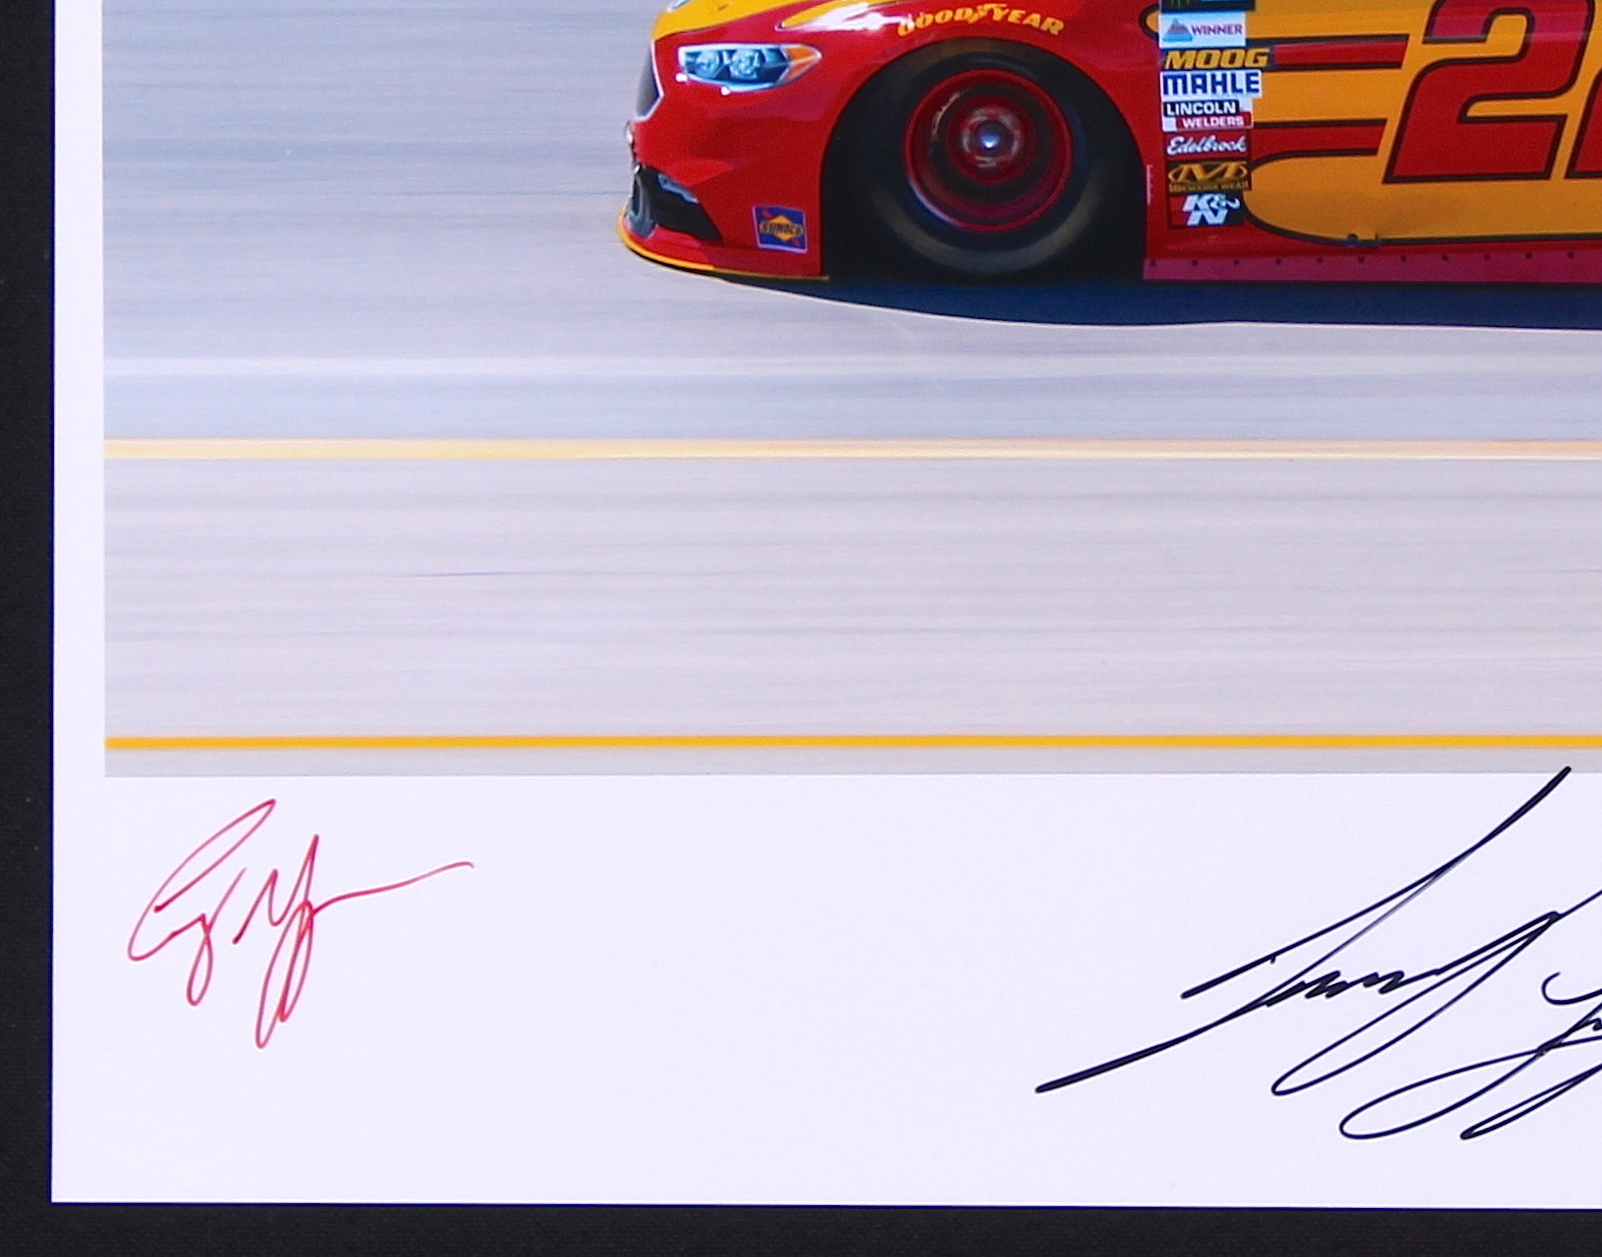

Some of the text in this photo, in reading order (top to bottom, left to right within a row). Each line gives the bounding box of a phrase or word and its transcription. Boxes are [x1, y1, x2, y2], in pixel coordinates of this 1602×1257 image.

[897, 3, 1064, 36] GOODYEAR
[1191, 24, 1242, 36] WINNER
[1165, 48, 1269, 69] MOOG
[1163, 72, 1259, 95] MAHLE
[1167, 102, 1236, 115] LINCOLN
[1183, 116, 1244, 128] WELDERS
[1167, 135, 1247, 155] Edelbrock
